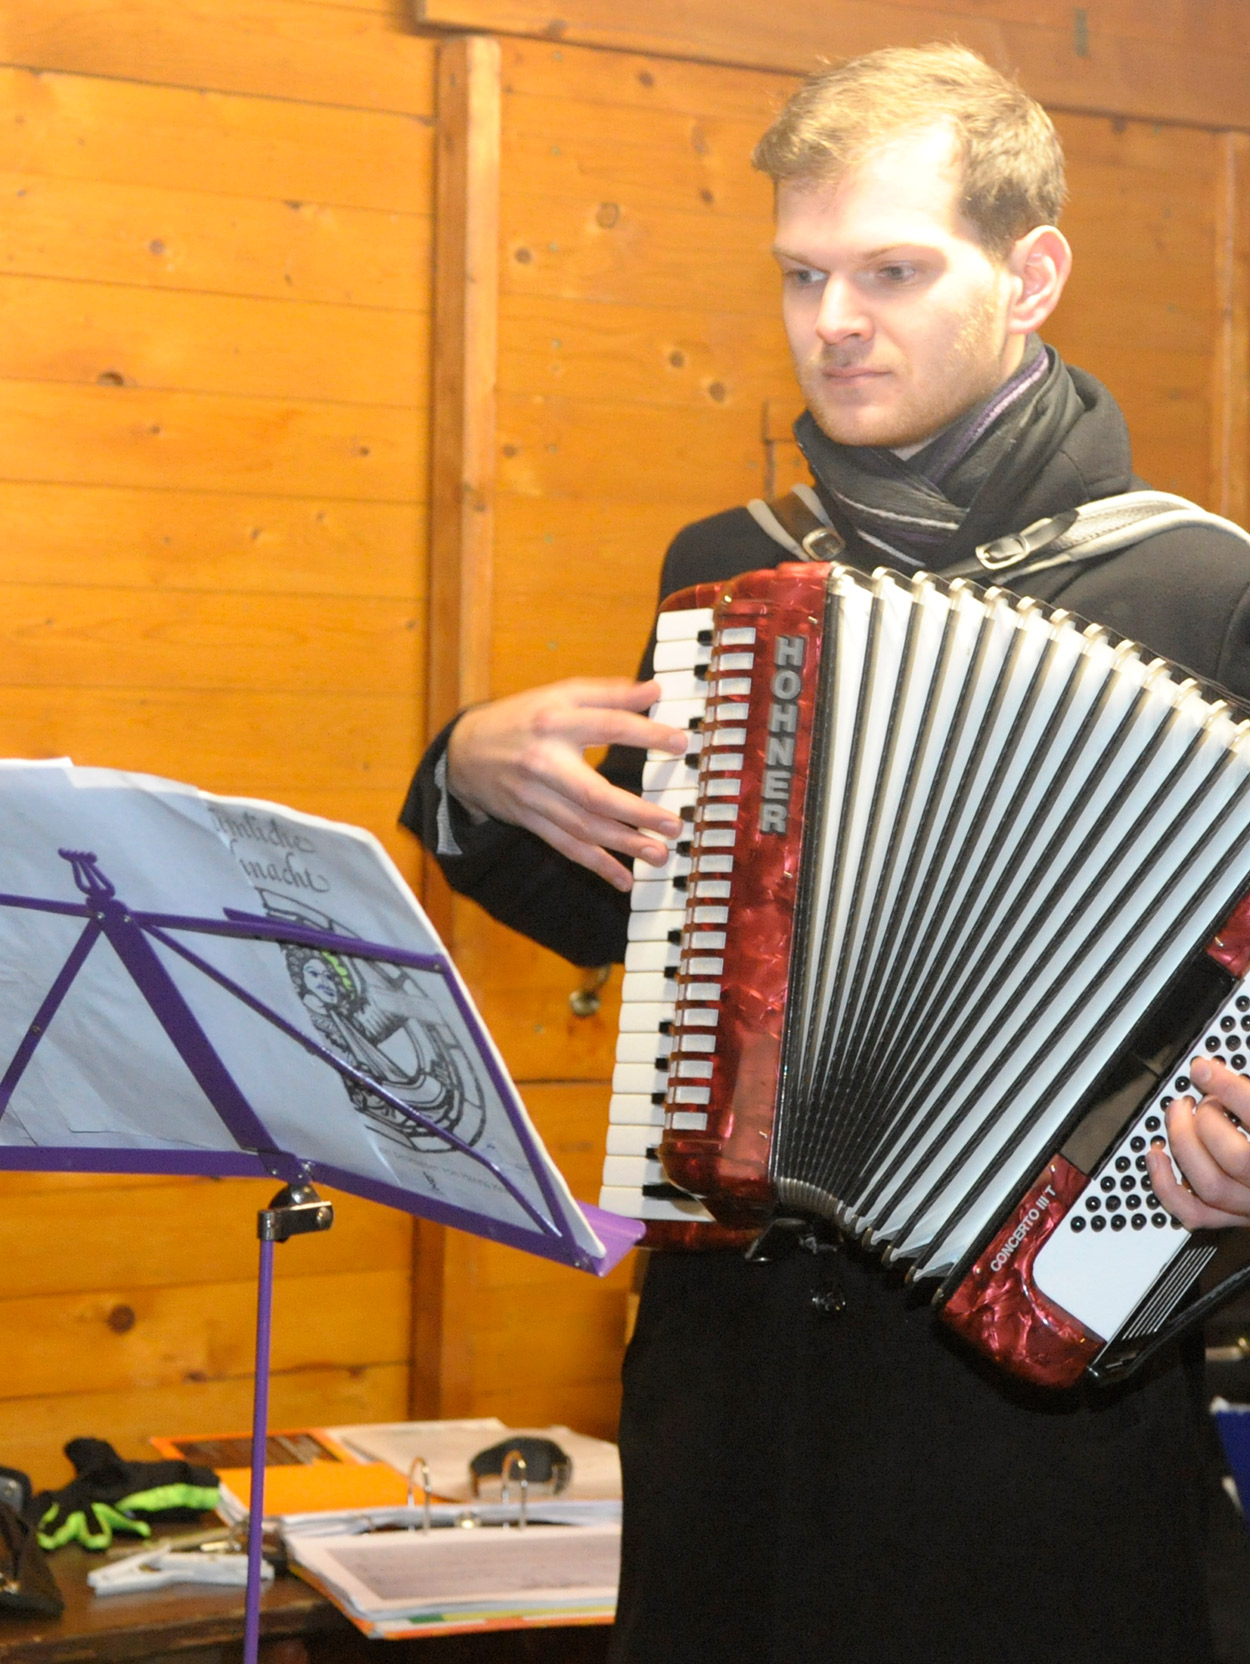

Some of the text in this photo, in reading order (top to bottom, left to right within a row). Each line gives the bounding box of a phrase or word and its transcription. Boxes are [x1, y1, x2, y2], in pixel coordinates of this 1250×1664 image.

[761, 634, 805, 835] HOHNER
[990, 1185, 1056, 1272] CONCERTO III T
